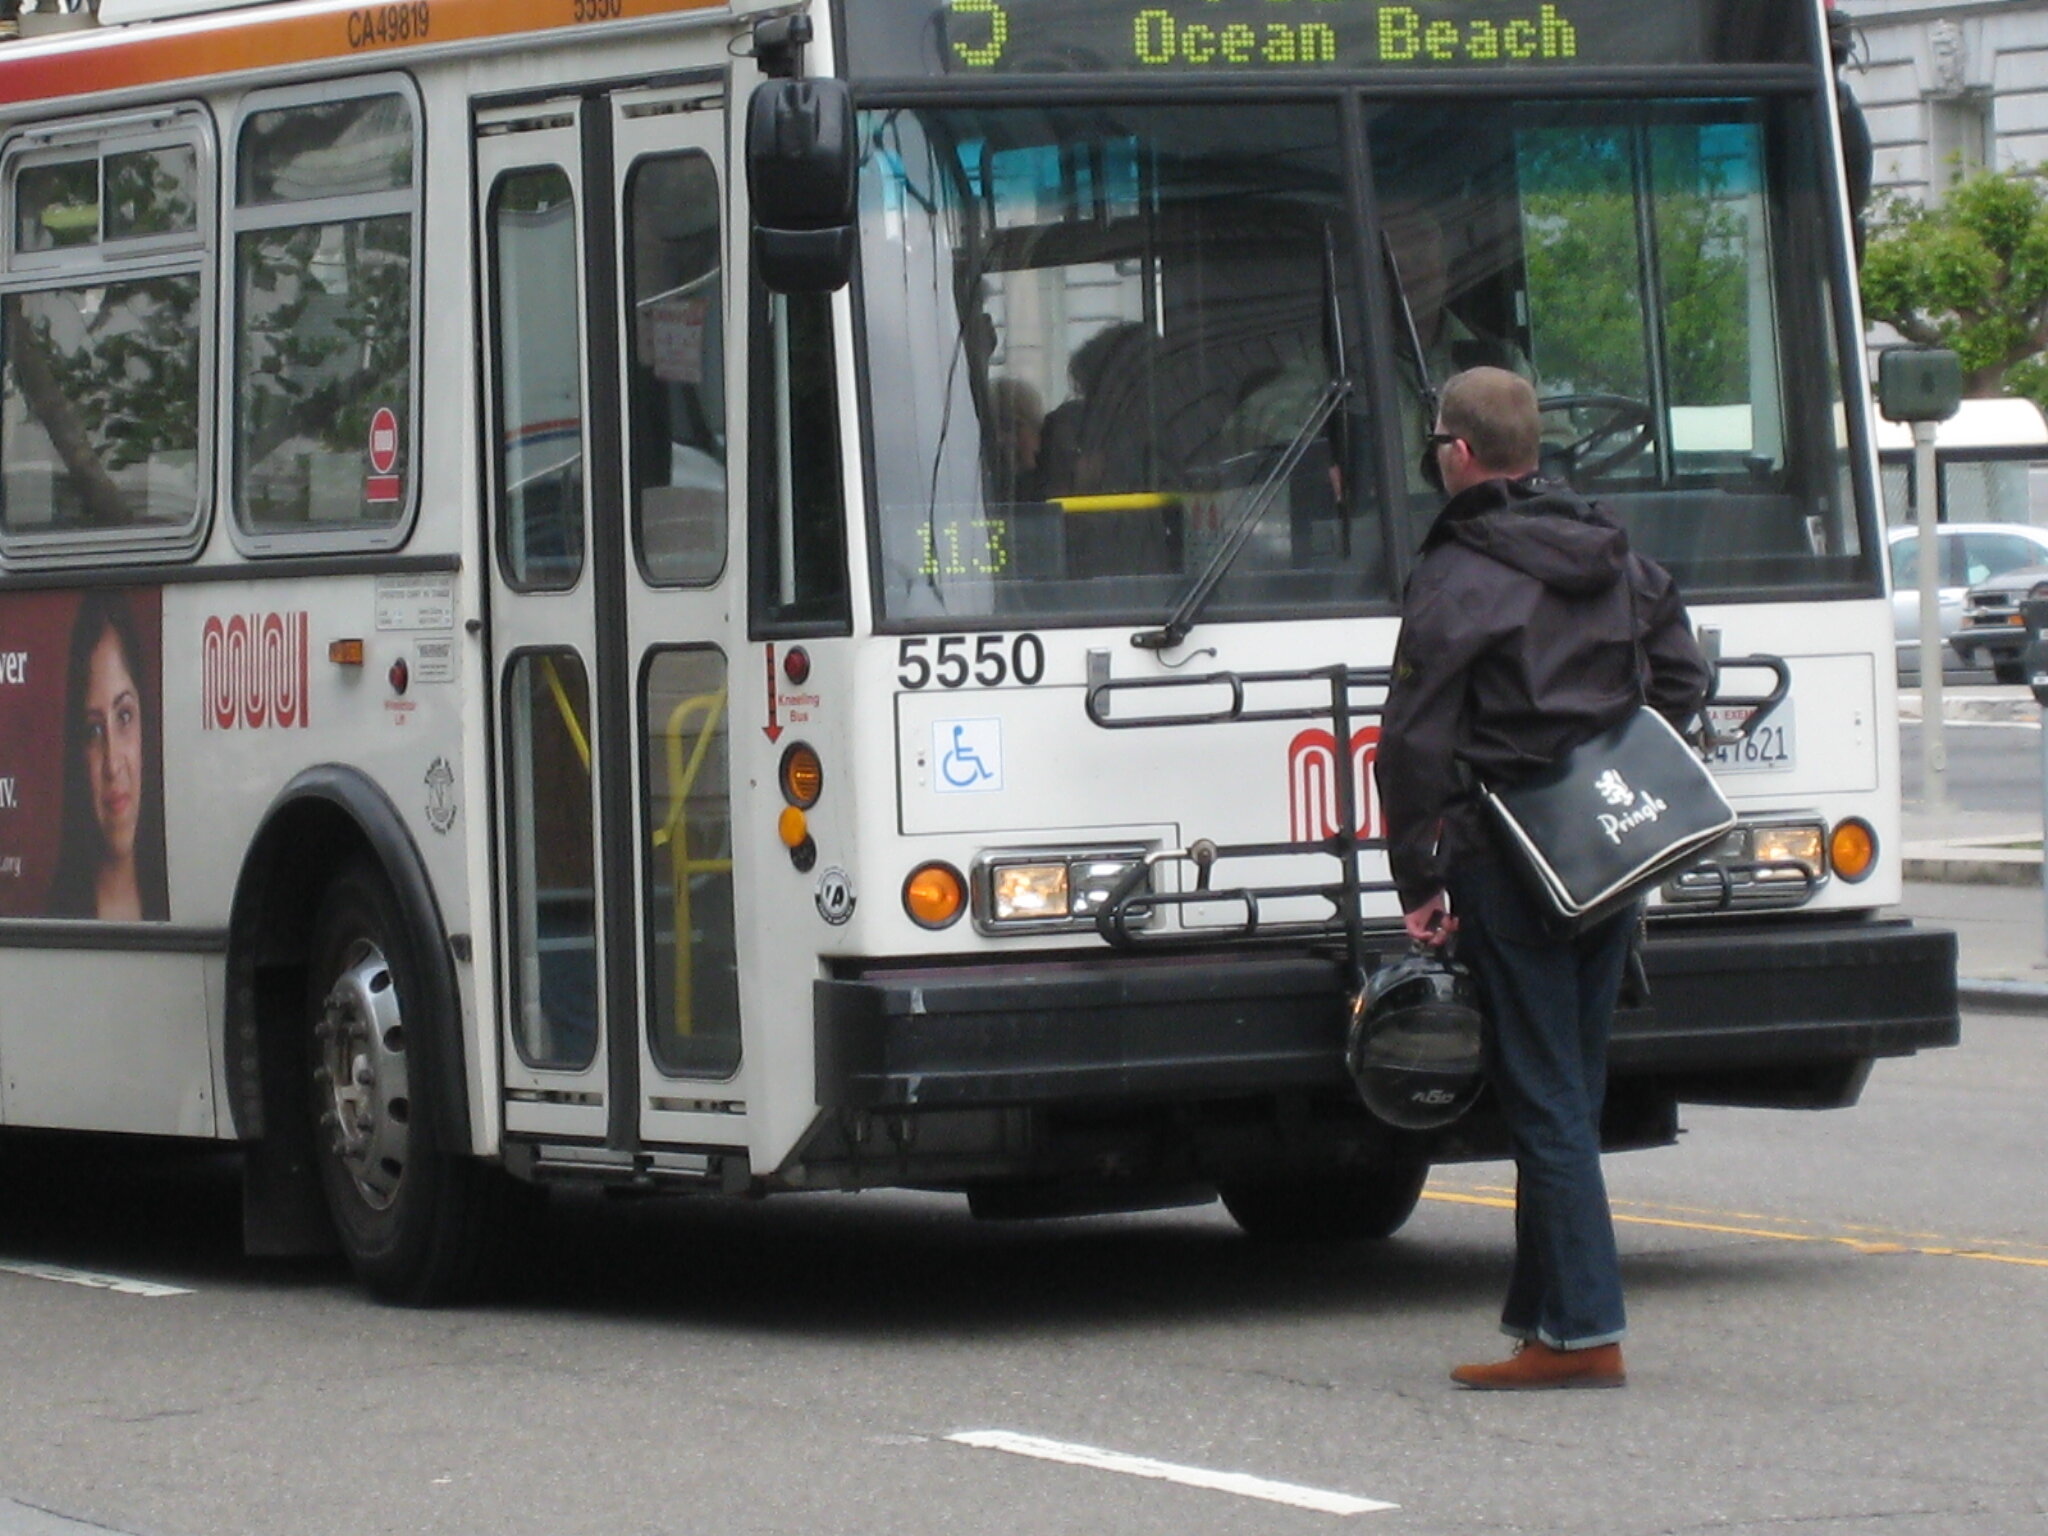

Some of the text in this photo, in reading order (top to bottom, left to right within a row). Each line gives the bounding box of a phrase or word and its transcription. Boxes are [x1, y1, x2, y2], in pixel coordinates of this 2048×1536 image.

[347, 1, 430, 48] CA49819
[1133, 4, 1577, 64] Ocean Beach
[916, 520, 1006, 574] 113
[897, 632, 1045, 690] 5550
[790, 710, 808, 722] Bus
[1596, 790, 1668, 845] Pringle
